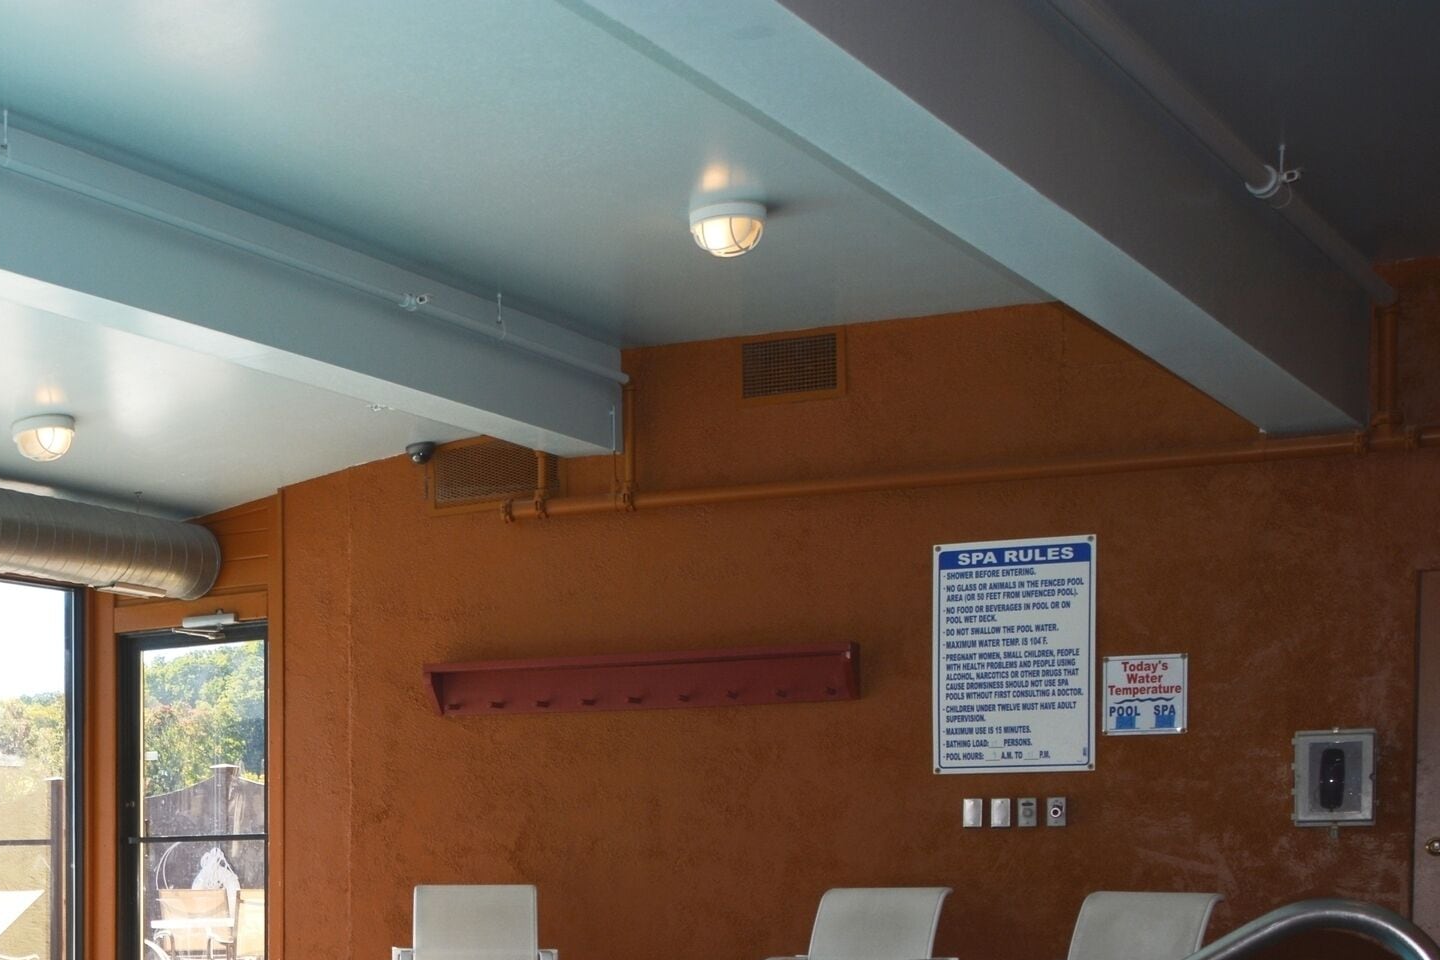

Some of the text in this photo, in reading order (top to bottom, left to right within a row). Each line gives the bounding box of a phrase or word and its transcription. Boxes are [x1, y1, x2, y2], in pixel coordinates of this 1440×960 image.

[958, 547, 1074, 565] SPA RULES
[946, 568, 1036, 580] SHOWER BEFORE ENTERING.
[957, 583, 977, 591] GLASS
[989, 581, 1016, 590] ANIMALS
[1027, 580, 1039, 588] THE
[1041, 579, 1065, 587] FENCED
[1067, 578, 1084, 586] POOL
[947, 594, 963, 602] AREA
[965, 594, 975, 602] (OR
[986, 592, 1001, 600] FEET
[1003, 591, 1020, 599] FROM
[1022, 590, 1055, 598] UNFENCED
[975, 605, 984, 613] OR
[986, 603, 1022, 612] BEVERAGES
[1032, 602, 1049, 610] POOL
[946, 616, 962, 624] POOL
[964, 615, 977, 623] WET
[946, 628, 955, 636] DO
[971, 626, 1000, 635] SWALLOW
[1035, 624, 1059, 632] WATER.
[946, 640, 977, 649] MAXIMUM
[979, 639, 1001, 648] WATER
[1002, 638, 1021, 646] TEMP.
[946, 648, 1080, 661] PREGNANT WOMEN, SMALL CHILDREN, PEOPLE
[946, 658, 1075, 671] WITH HEALTH PROBLEMS AND PEOPLE USING
[1121, 661, 1168, 673] Today's
[946, 668, 1079, 681] ALCOHOL, NARCOTICS OR OTHER DRUGS THAT
[1127, 674, 1163, 684] Water
[967, 681, 1004, 690] DROWSINESS
[1006, 680, 1029, 688] SHOULD
[1031, 679, 1042, 687] NOT
[946, 692, 965, 700] POOLS
[966, 691, 992, 699] WITHOUT
[994, 690, 1011, 698] FIRST
[1013, 689, 1051, 698] CONSULTING
[1057, 688, 1084, 696] DOCTOR.
[1108, 685, 1181, 697] Temperature
[946, 705, 974, 713] CHILDREN
[976, 704, 996, 712] UNDER
[998, 703, 1020, 711] TWELVE
[1040, 702, 1056, 710] HAVE
[1057, 701, 1076, 709] ADULT
[1110, 704, 1176, 716] POOL SPA
[946, 714, 986, 723] SUPERVISION.
[946, 726, 1031, 735] MAXIMUM USE IS 15 MINUTES.
[946, 740, 971, 748] BATHING
[973, 739, 989, 747] LOAD:
[946, 750, 1050, 761] POOL HOURS: A.M. TO P.M.
